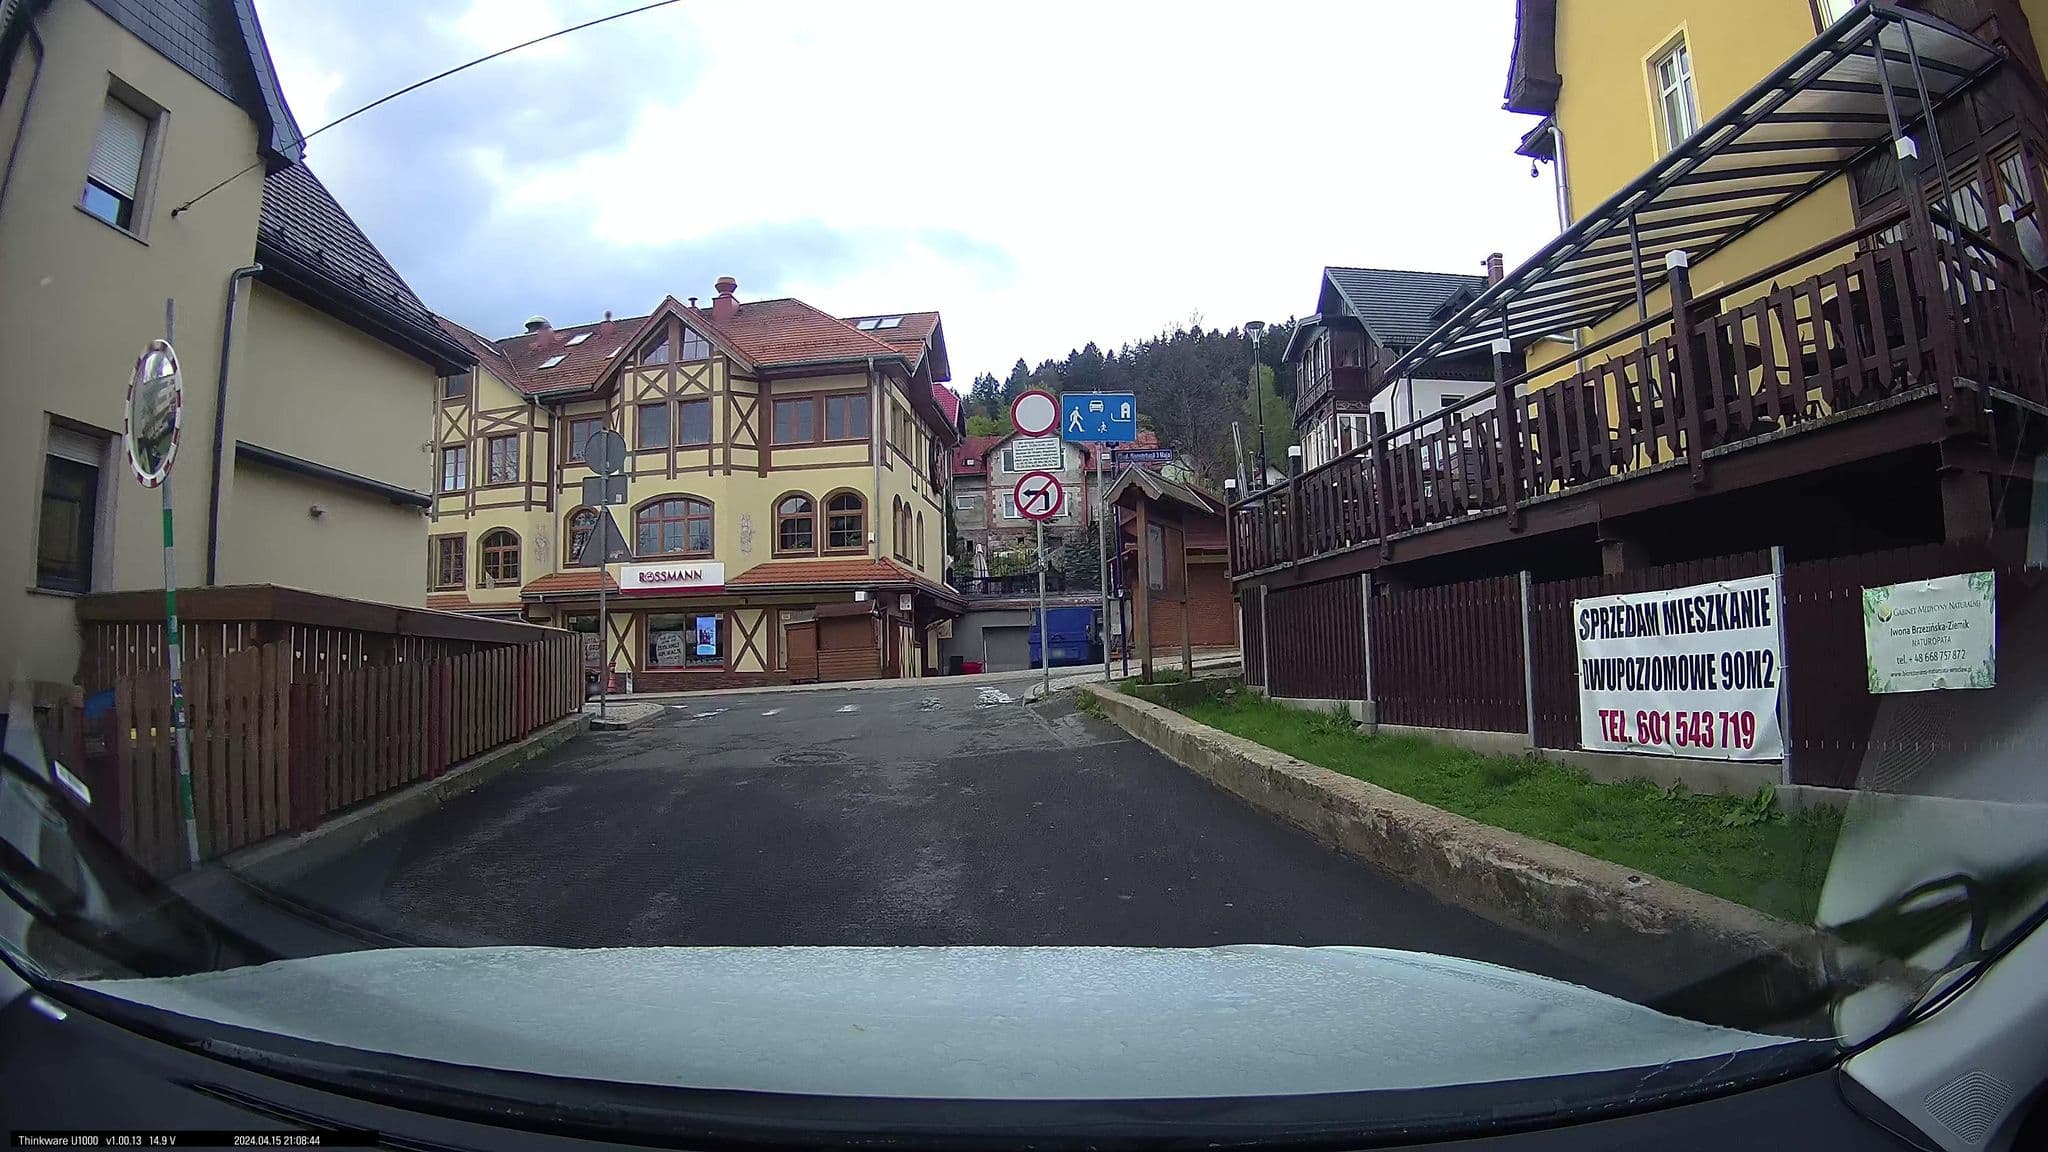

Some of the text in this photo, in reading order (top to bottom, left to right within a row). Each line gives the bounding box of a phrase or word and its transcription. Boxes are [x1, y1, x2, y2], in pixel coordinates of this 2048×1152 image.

[639, 569, 703, 583] ROSSMANN
[1579, 588, 1771, 640] SPRZEDAM MIESZKANIE
[1890, 627, 1911, 637] Iwona
[1911, 636, 1952, 646] NATUROPATA
[1896, 654, 1907, 665] tel.
[1924, 651, 1939, 662] 668
[1582, 649, 1775, 691] DWUPOZIOMOWE 90M2
[1598, 709, 1756, 749] TEL. 601 543 719
